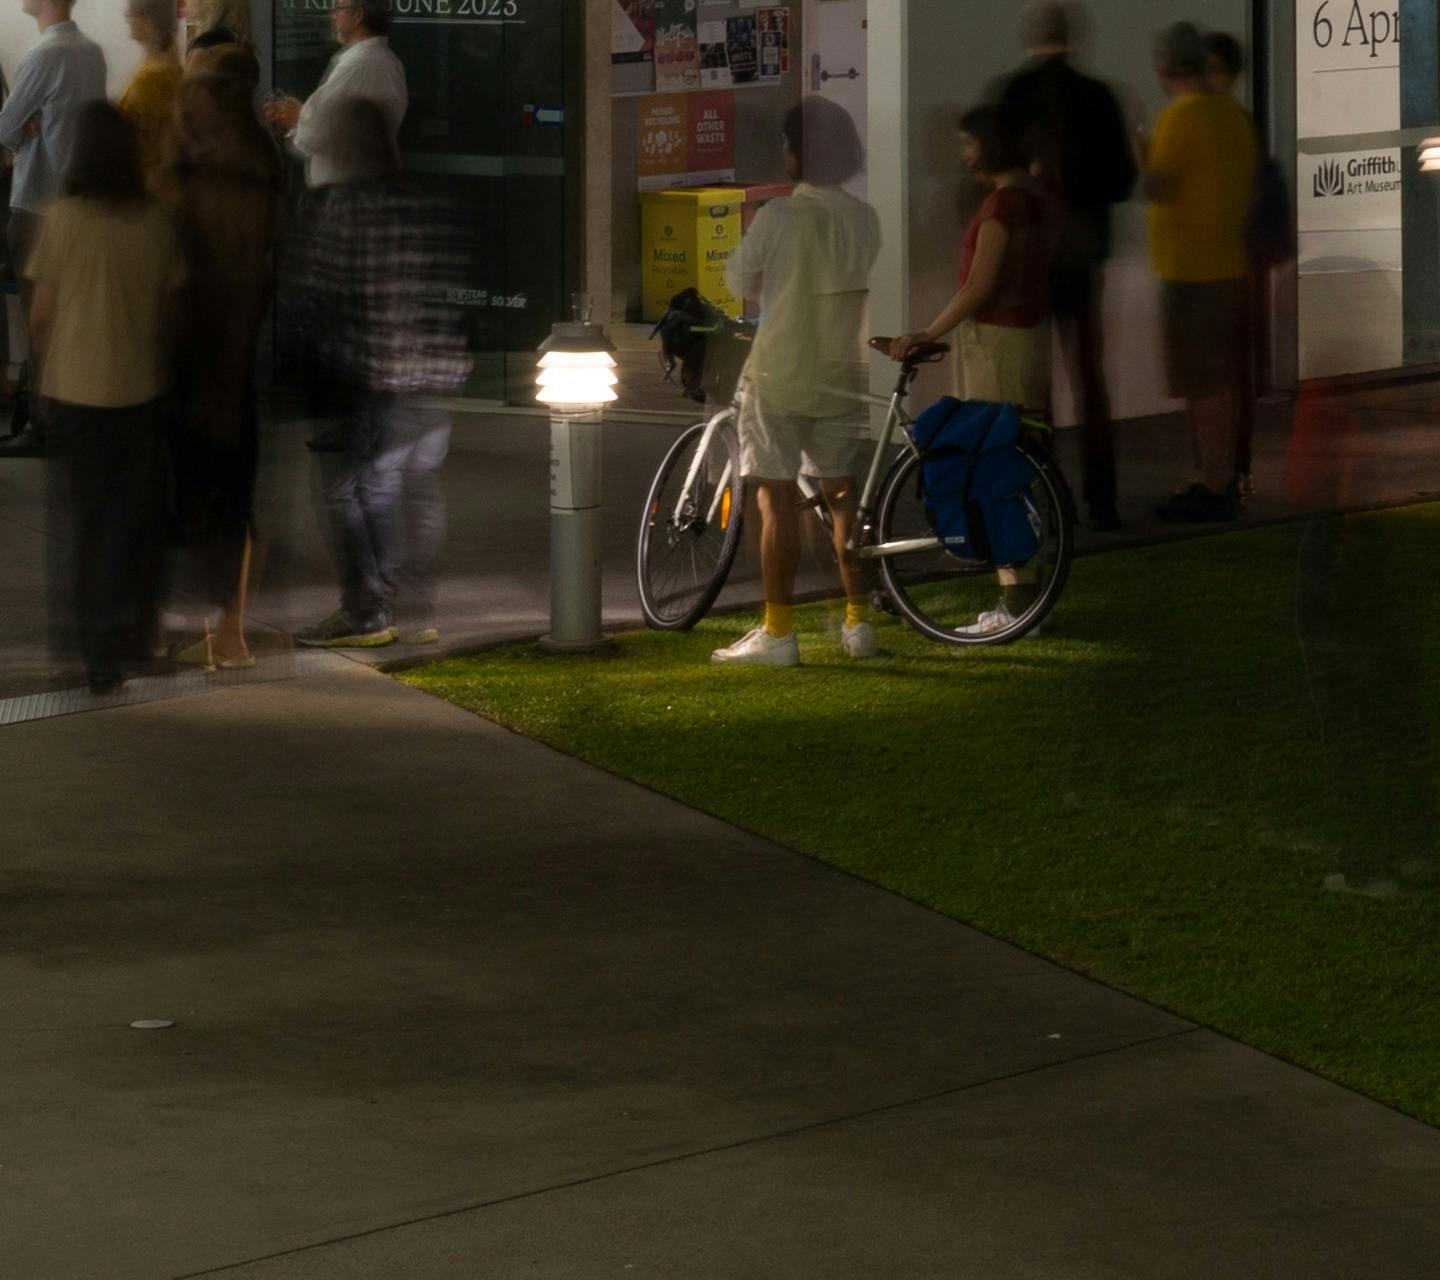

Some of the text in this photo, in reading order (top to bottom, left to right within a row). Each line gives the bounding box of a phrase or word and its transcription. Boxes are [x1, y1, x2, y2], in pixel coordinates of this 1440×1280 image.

[1313, 0, 1333, 48] 6
[703, 109, 719, 120] ALL
[696, 120, 725, 132] OTHER
[695, 132, 725, 145] WASTE
[1347, 156, 1396, 177] Griffith
[1346, 182, 1362, 195] Art
[652, 249, 686, 262] Mixed
